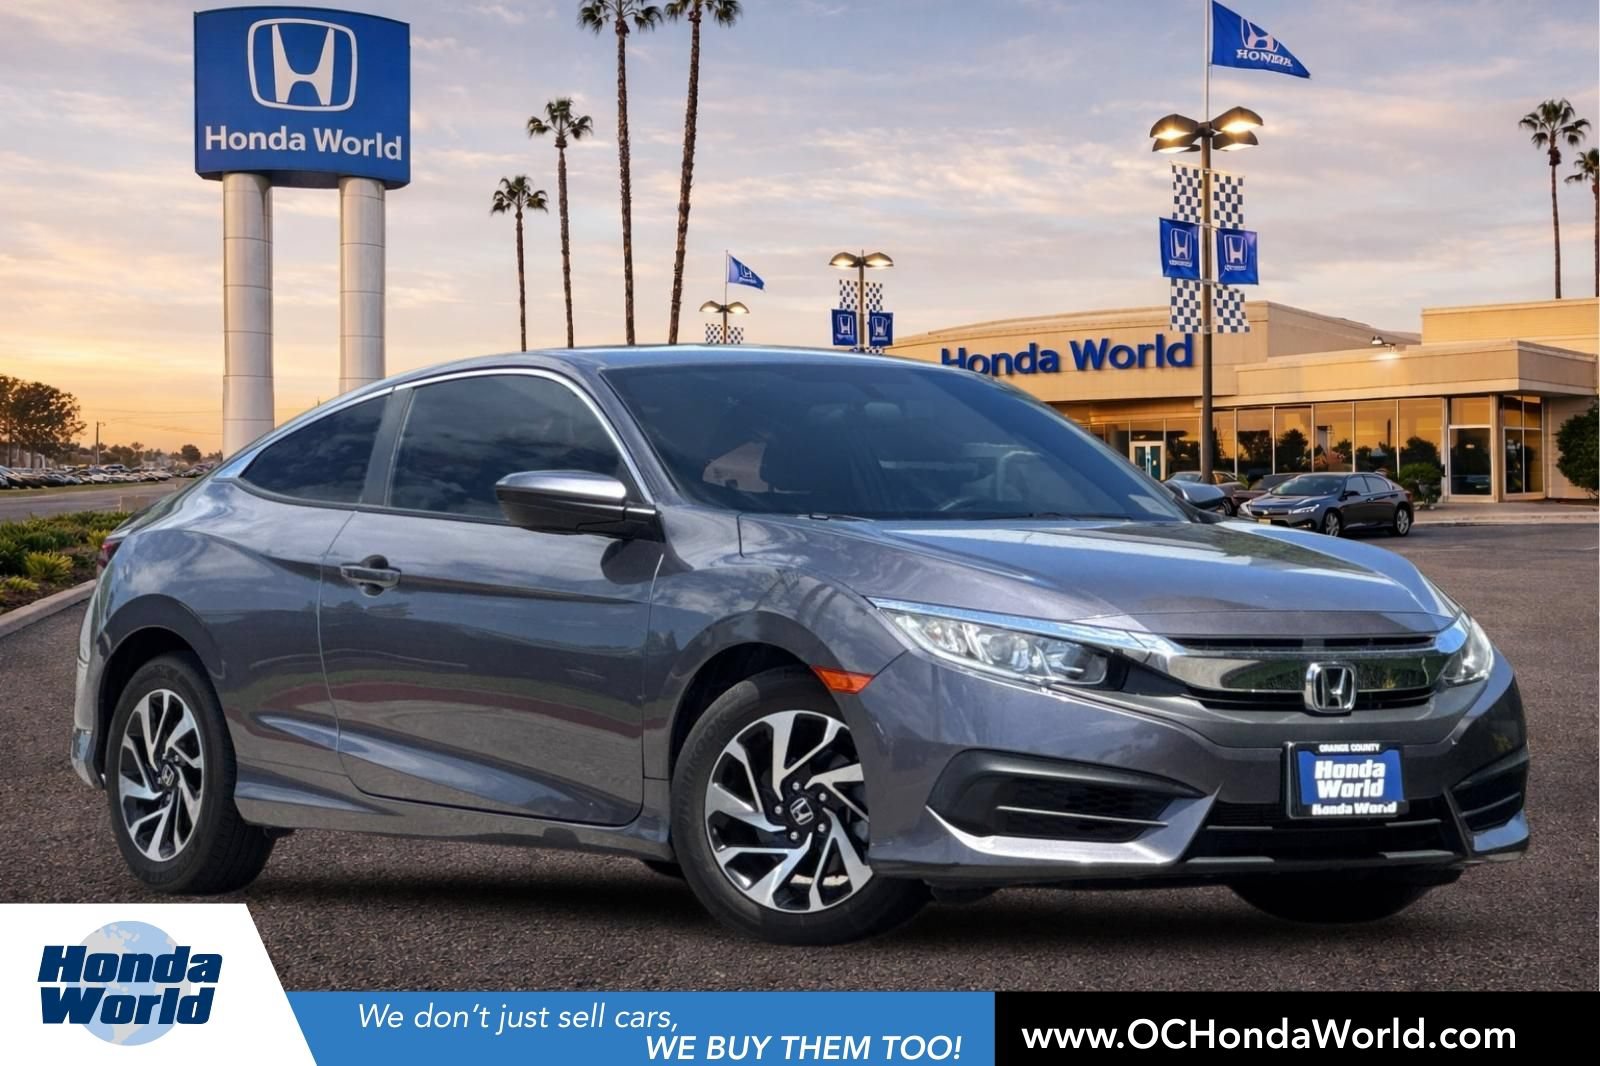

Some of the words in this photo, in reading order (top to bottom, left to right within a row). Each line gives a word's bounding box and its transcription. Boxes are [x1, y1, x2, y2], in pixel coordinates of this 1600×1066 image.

[205, 125, 306, 151] Honda
[313, 127, 402, 161] World
[1069, 333, 1194, 371] World
[1350, 743, 1380, 752] COUNTY
[1314, 759, 1386, 779] Honda
[1317, 779, 1385, 799] World
[1311, 803, 1353, 815] Honda
